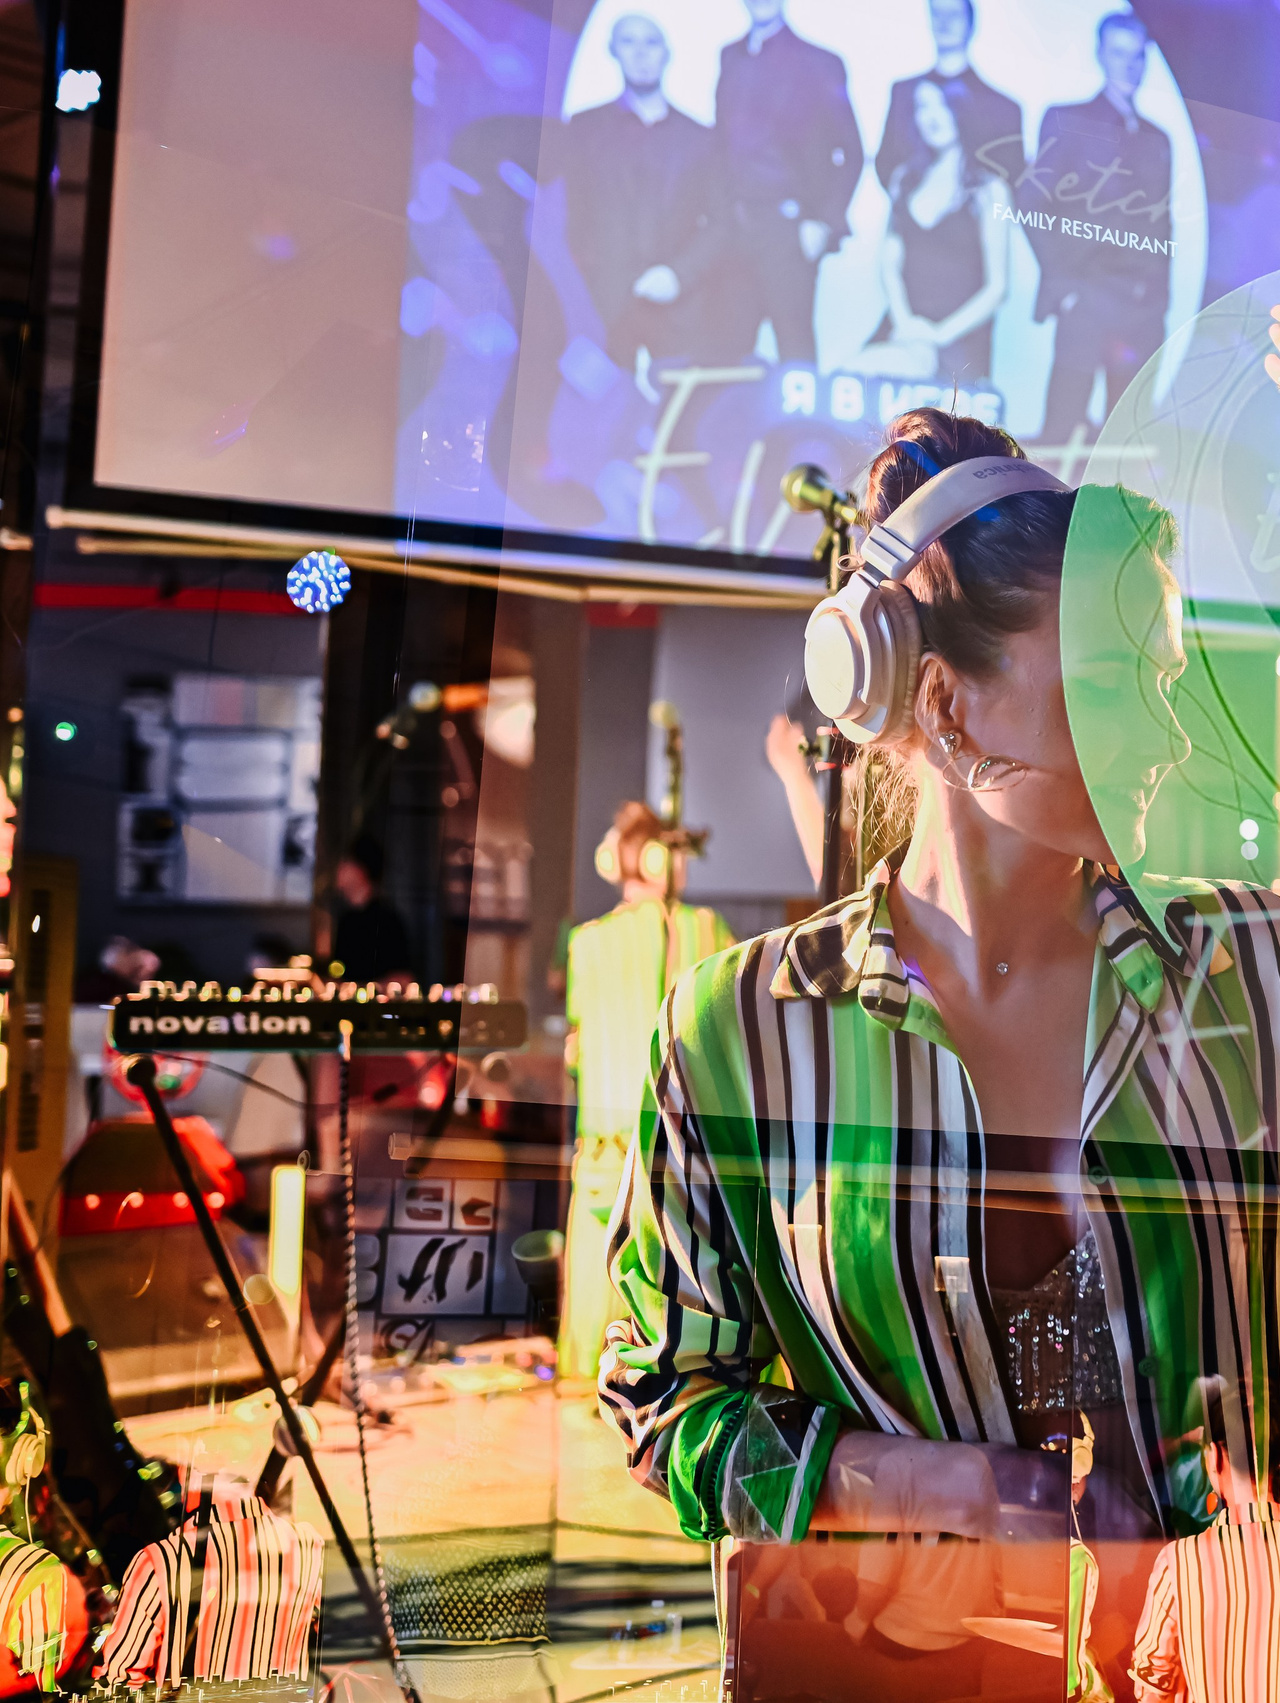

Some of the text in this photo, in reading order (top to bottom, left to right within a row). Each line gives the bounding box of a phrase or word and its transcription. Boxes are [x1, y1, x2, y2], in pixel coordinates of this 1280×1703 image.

[992, 203, 1178, 258] FAMILY RESTAURANT
[783, 370, 816, 416] Я
[128, 1012, 311, 1035] novation
